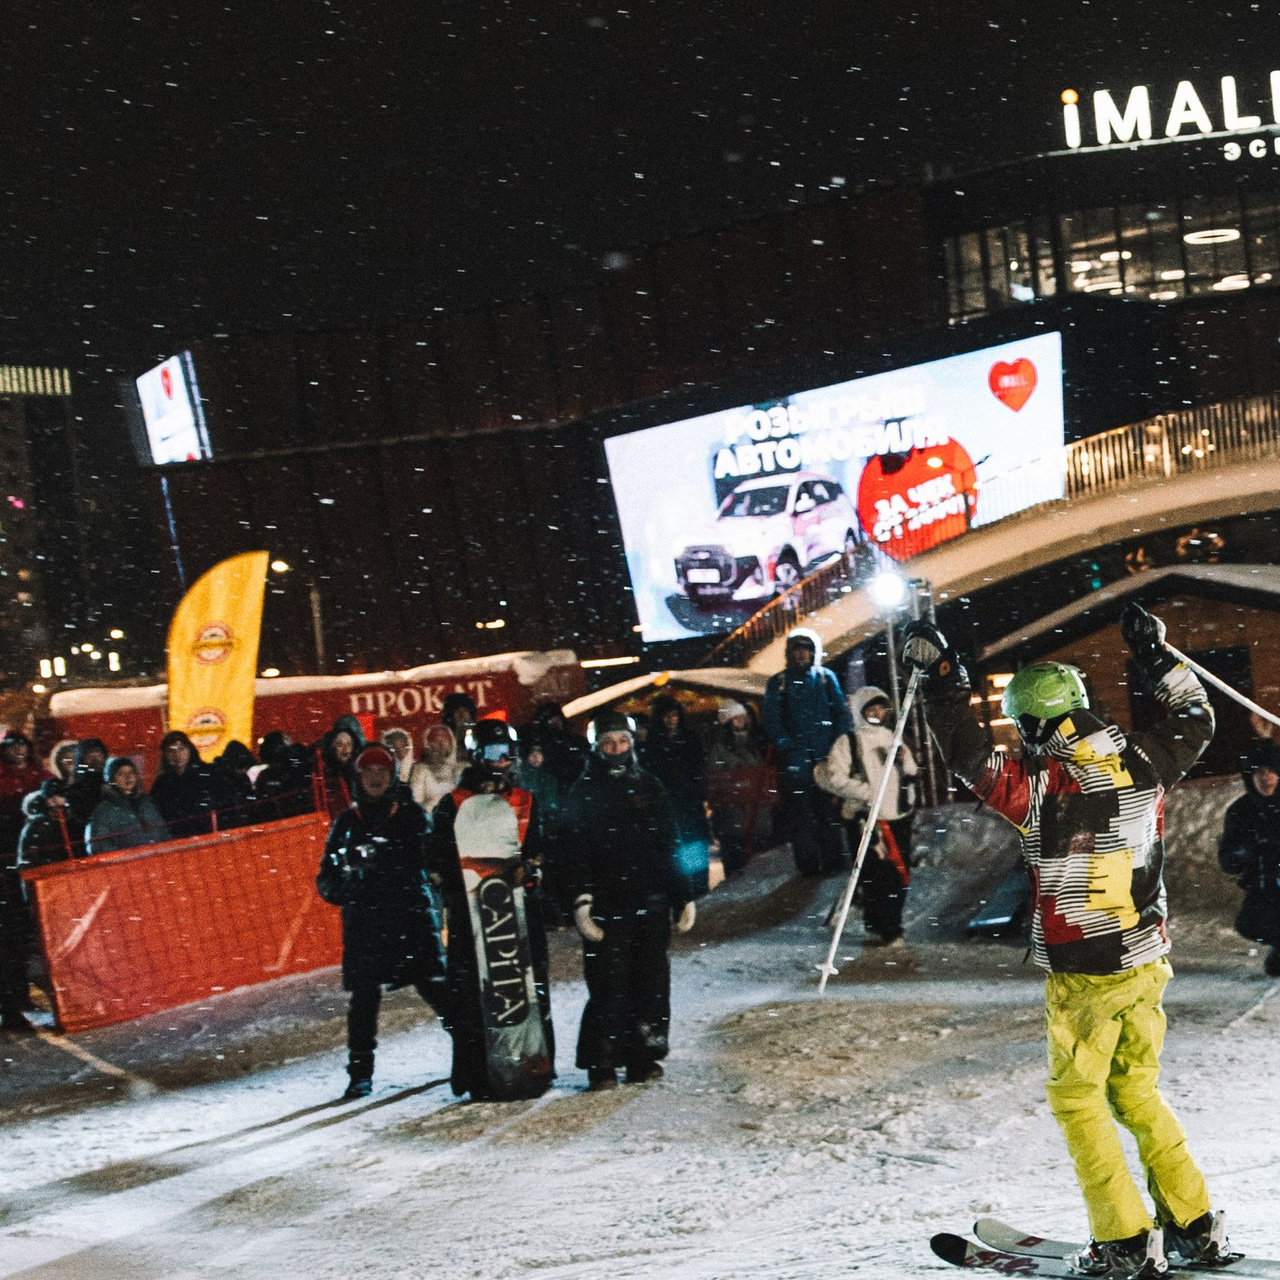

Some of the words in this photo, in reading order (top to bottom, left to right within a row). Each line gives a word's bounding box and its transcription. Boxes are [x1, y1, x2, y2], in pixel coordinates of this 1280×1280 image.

[723, 384, 926, 444] РОЗЫГРЫШ
[715, 415, 948, 477] АВТОМОБИЛЯ
[350, 679, 493, 718] ПРОКТ
